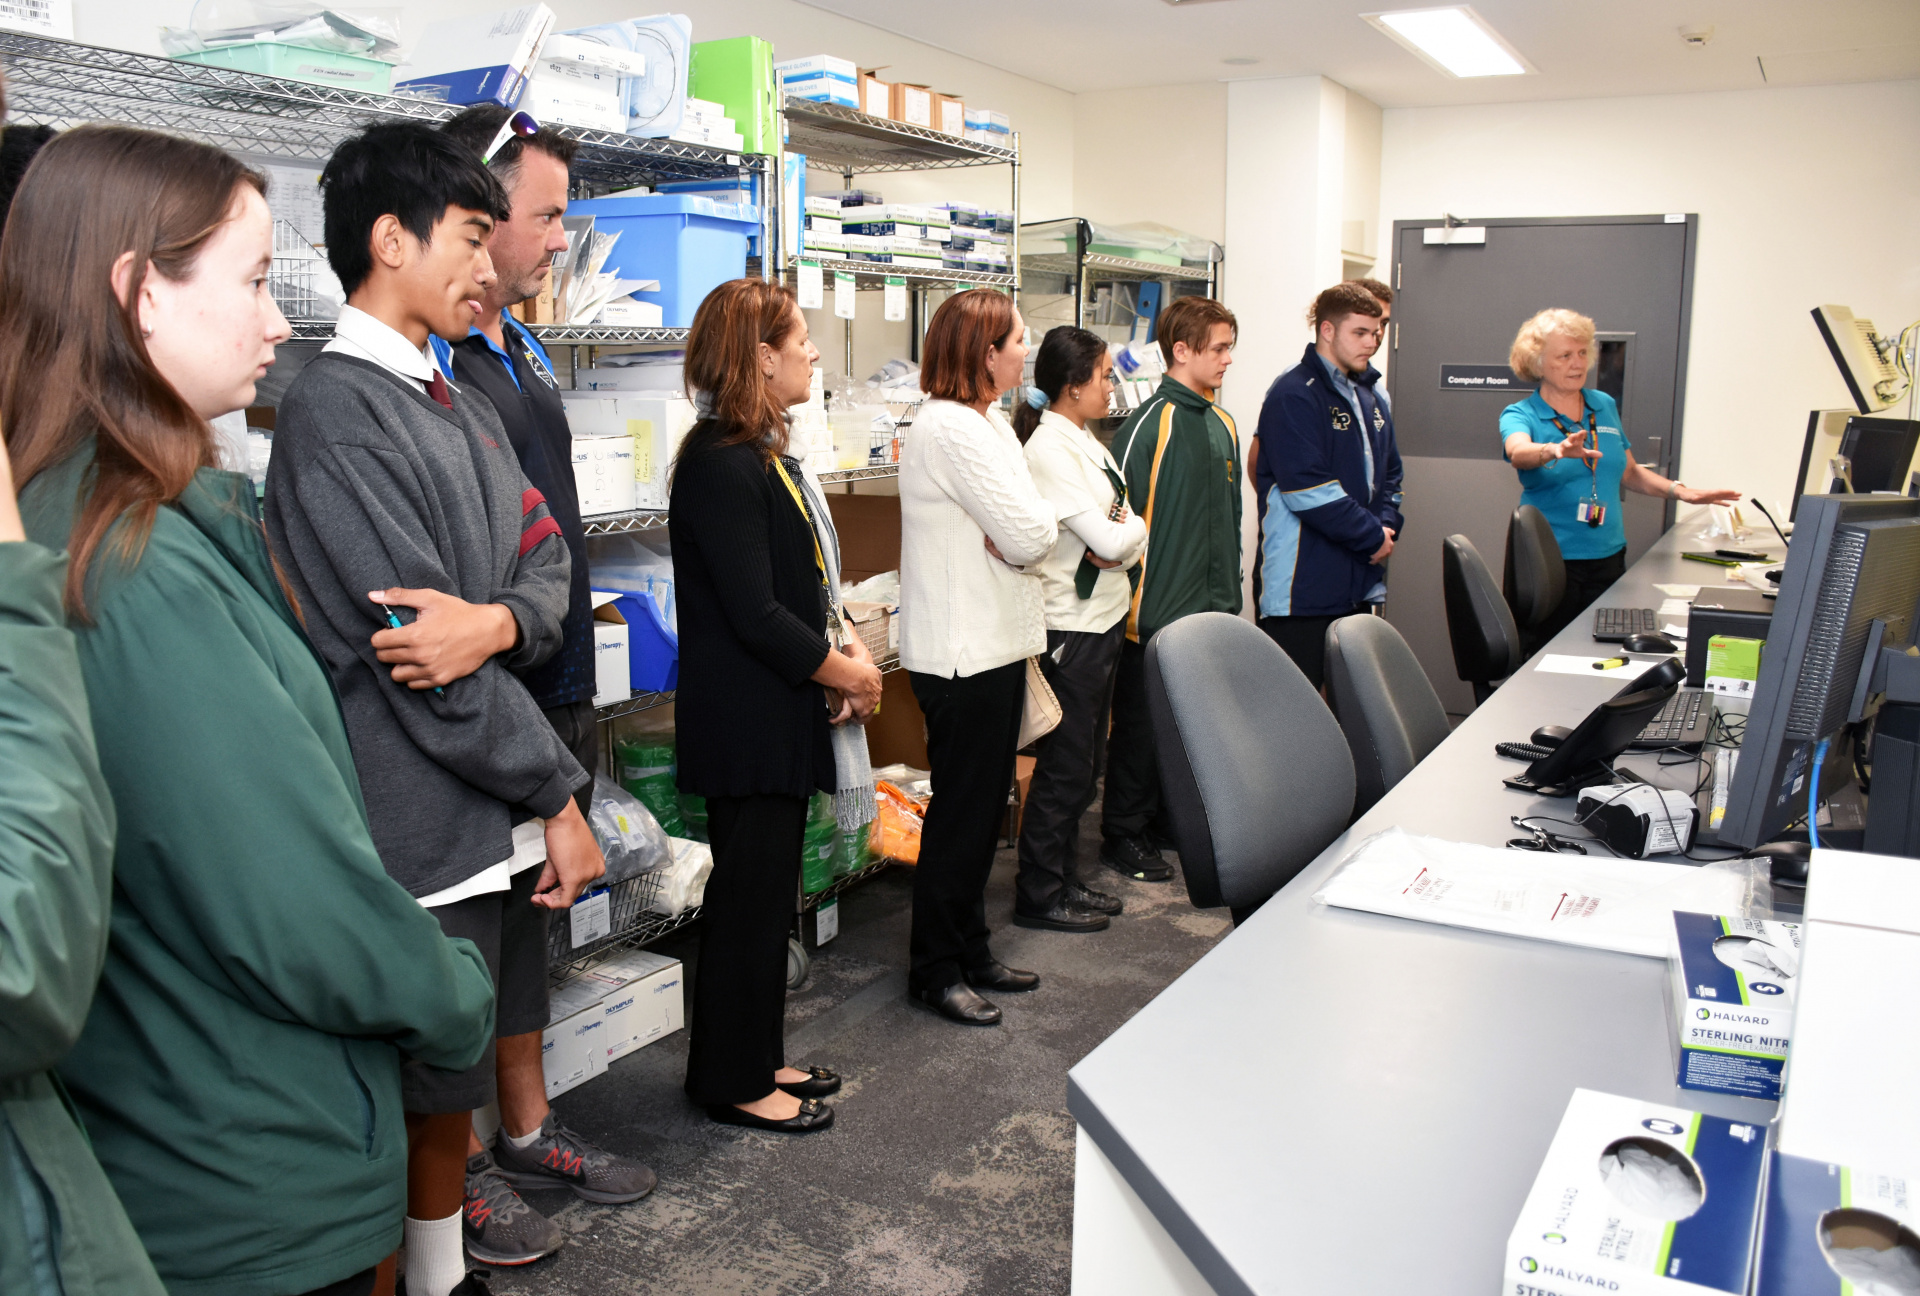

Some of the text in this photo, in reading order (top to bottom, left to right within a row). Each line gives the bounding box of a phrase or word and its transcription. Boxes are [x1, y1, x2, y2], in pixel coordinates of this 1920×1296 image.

[1447, 375, 1509, 386] Computer Room
[1713, 1011, 1770, 1026] HALYARD
[1690, 1037, 1748, 1050] POWDER-FREE
[1749, 1044, 1771, 1053] EXAM
[1691, 1027, 1754, 1044] STERLING
[1552, 1186, 1579, 1230] HALYARD
[1597, 1216, 1621, 1258] STERLING
[1614, 1227, 1634, 1262] NITRILE
[1543, 1264, 1620, 1291] HALYARD
